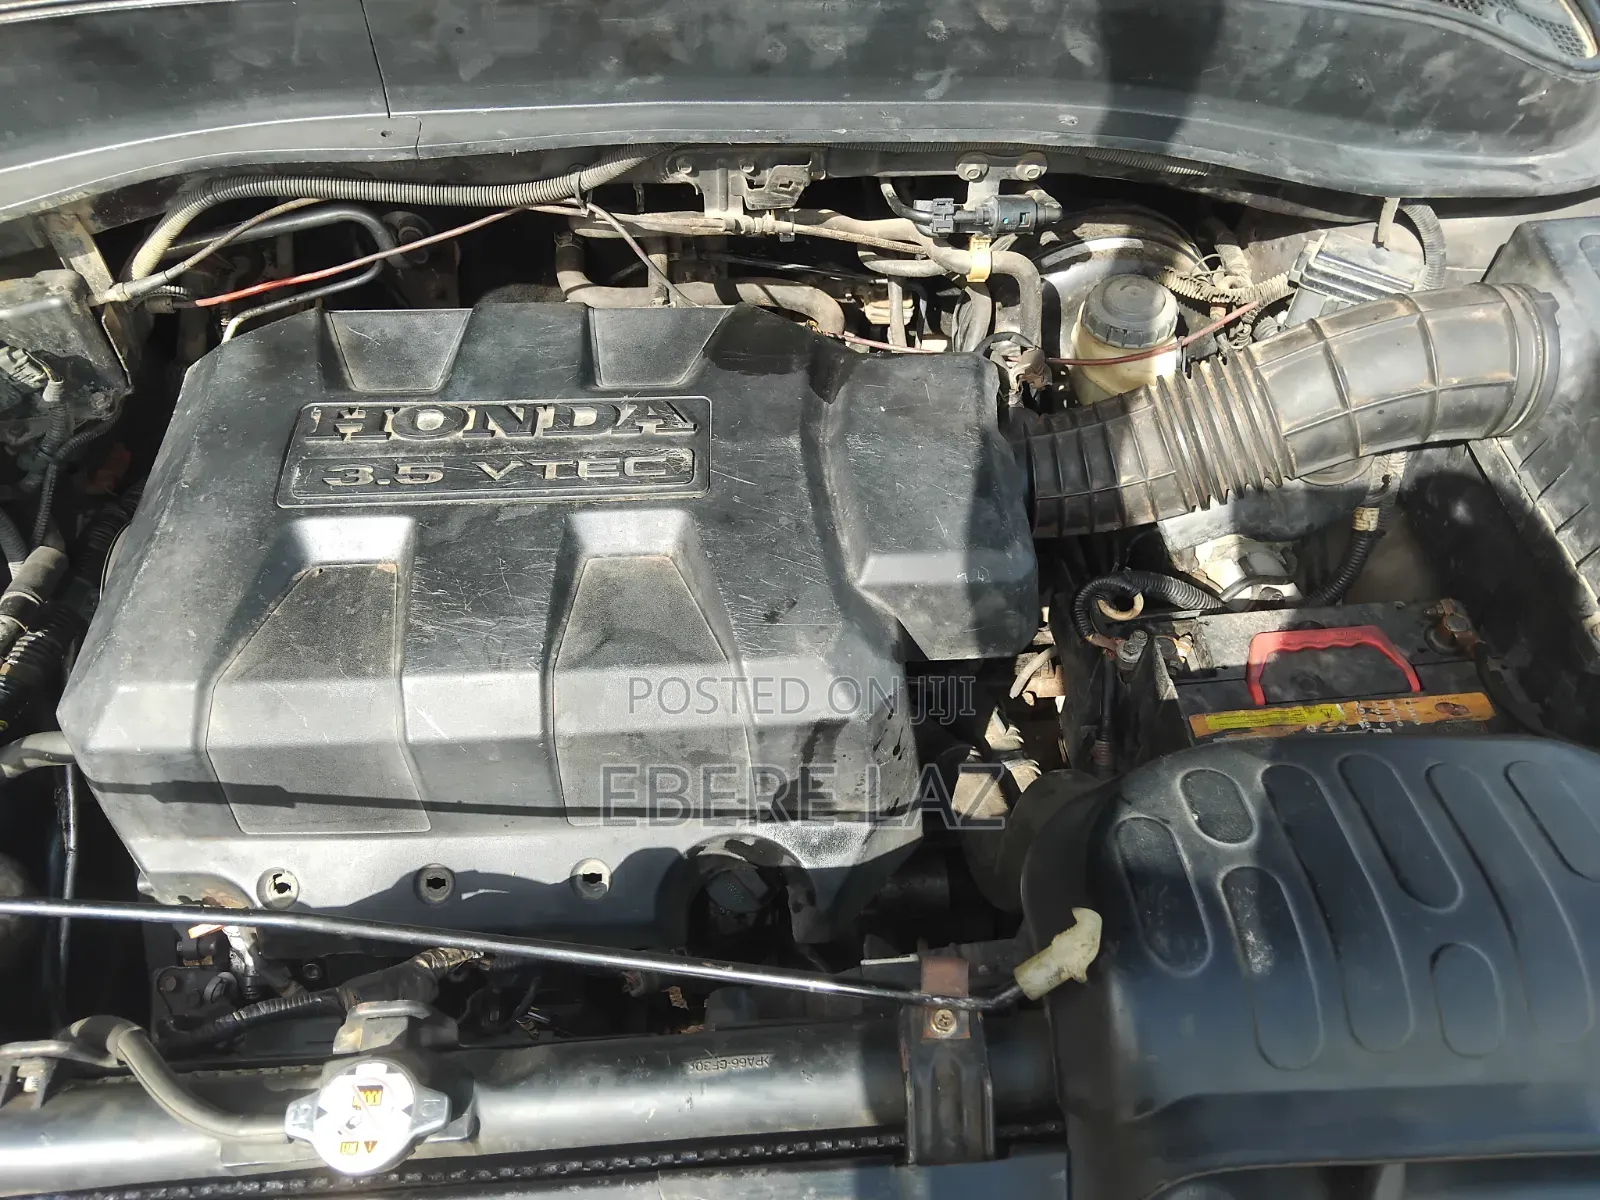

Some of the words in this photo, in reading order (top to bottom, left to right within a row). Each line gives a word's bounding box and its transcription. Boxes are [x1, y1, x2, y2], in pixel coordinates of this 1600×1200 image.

[305, 403, 698, 441] HONDA
[322, 462, 445, 486] 3.5
[475, 456, 668, 480] VTEC
